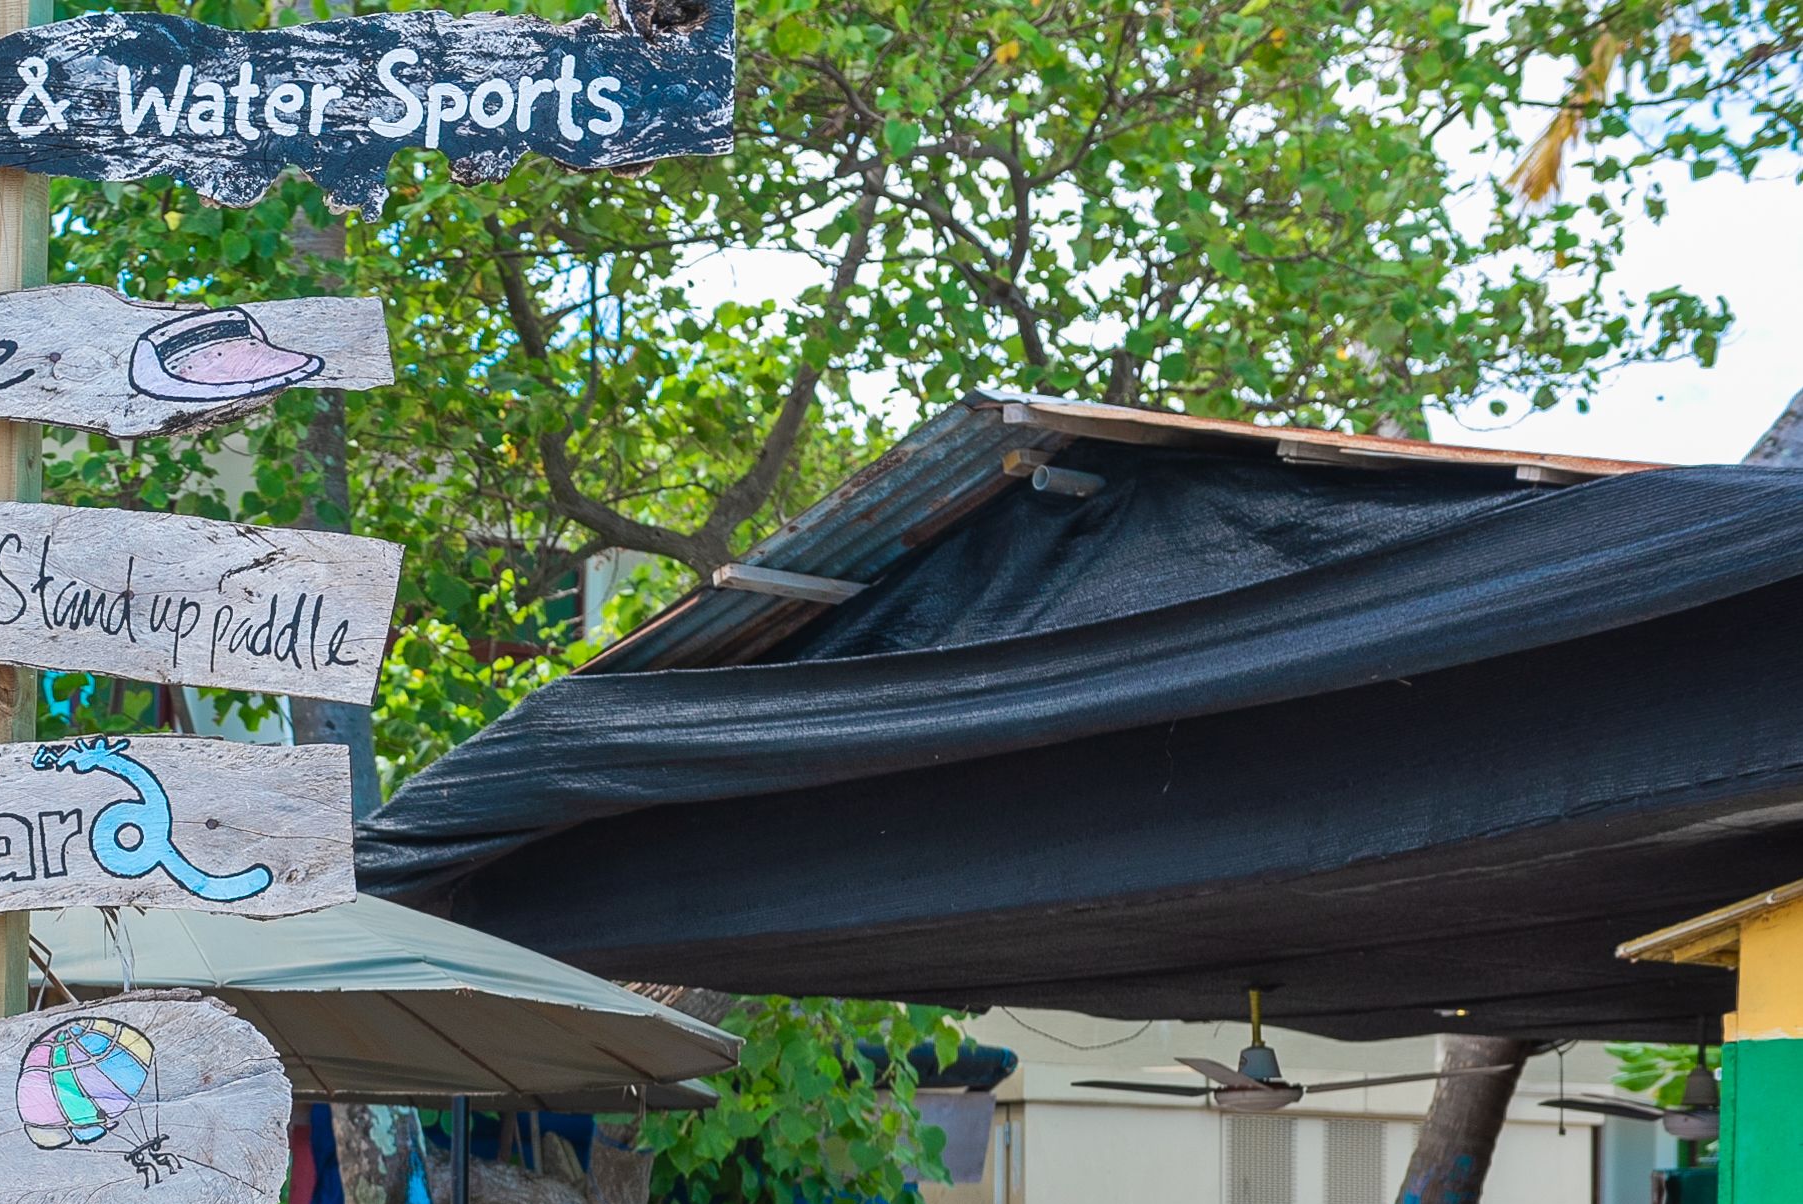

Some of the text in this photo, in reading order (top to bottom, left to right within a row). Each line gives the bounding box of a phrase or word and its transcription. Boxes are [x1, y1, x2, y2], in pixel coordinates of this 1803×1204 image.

[7, 55, 71, 138] &
[117, 61, 344, 141] Water
[368, 48, 625, 149] Sports
[149, 593, 200, 668] up
[210, 592, 359, 673] paddle
